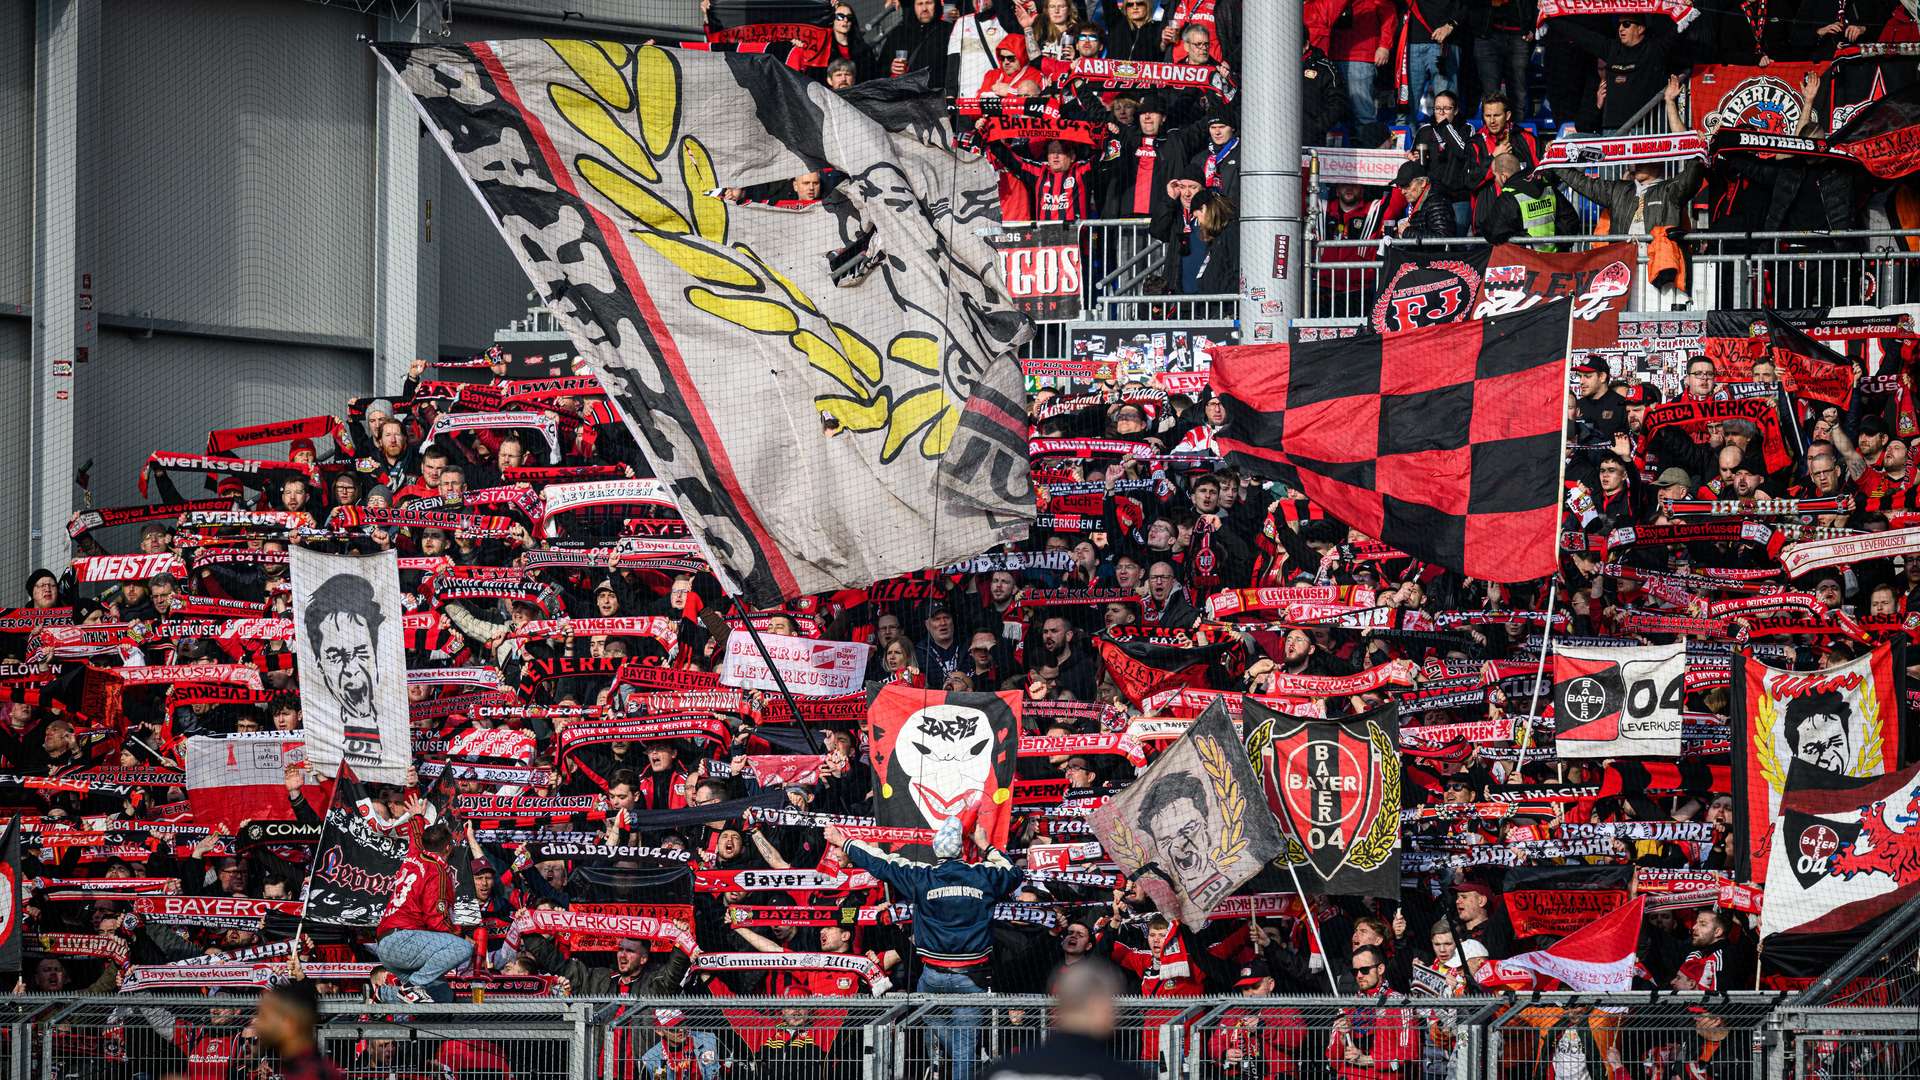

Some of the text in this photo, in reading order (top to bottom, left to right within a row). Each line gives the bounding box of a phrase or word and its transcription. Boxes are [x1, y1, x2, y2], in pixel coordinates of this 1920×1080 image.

[1142, 67, 1208, 82] ALONSO
[1018, 130, 1060, 138] LEVERKUSEN
[1740, 133, 1815, 151] BROTHERS
[1043, 193, 1069, 203] RWE
[1391, 286, 1462, 332] FJ
[1814, 323, 1897, 336] 04 Leverkusen
[1043, 361, 1063, 369] Kids
[1028, 368, 1091, 378] Leverkusen
[462, 389, 500, 406] Bayer
[436, 419, 450, 430] 04
[236, 422, 305, 443] werkself
[1045, 440, 1132, 453] TRAUM WURDE
[157, 455, 262, 474] werkself
[103, 499, 233, 522] Bayer Leverkusen
[365, 508, 482, 527] NORDKURVE
[1037, 517, 1093, 531] LEVERKUSEN
[1636, 523, 1740, 540] Bayer Leverkusen
[637, 540, 668, 552] Bayer
[1832, 544, 1855, 555] BAYER
[1861, 536, 1906, 550] LEVERKUSEN
[448, 588, 526, 599] LEVERKUSEN
[1265, 587, 1330, 600] LEVERKUSEN
[1747, 597, 1782, 607] DEUTSCHER
[1786, 594, 1812, 605] MEISTER
[0, 618, 16, 628] ER
[18, 617, 32, 627] 04
[226, 619, 234, 630] &
[1341, 607, 1389, 627] SVB
[156, 624, 222, 638] LEVERKUSEN
[836, 652, 856, 661] Bayer
[623, 667, 657, 682] BAYER
[661, 671, 675, 683] 04
[1283, 676, 1370, 692] LEVERKUSEN
[1568, 694, 1603, 704] BAYER
[1581, 680, 1591, 718] BAYER
[1626, 673, 1683, 719] 04
[479, 707, 523, 717] CHAME
[572, 728, 595, 740] BAYER
[619, 724, 659, 734] DEUTSCHER
[663, 721, 692, 730] MEISTER
[1622, 720, 1681, 732] LEVERKUSE
[426, 730, 440, 739] 04
[454, 734, 463, 747] &
[100, 773, 115, 784] 04
[1289, 774, 1358, 791] BAYER
[1315, 745, 1332, 823] BAYER
[496, 794, 592, 810] 04 Leverkusen
[1490, 786, 1600, 803] DIE MACHT
[113, 821, 210, 835] 04 Leverkusen
[1653, 823, 1714, 842] JAHRE
[1307, 828, 1346, 851] 04
[1801, 835, 1837, 850] BAYER
[1797, 856, 1829, 875] 04
[745, 871, 801, 888] Bayer
[927, 886, 983, 901] CHEVIGNON SPORT
[541, 911, 651, 932] LEVERKUSEN
[760, 909, 833, 920] BAYER 04
[860, 910, 875, 919] FC
[700, 956, 716, 968] 04
[717, 953, 797, 969] Commando
[141, 969, 249, 982] Bayer Leverkusen
